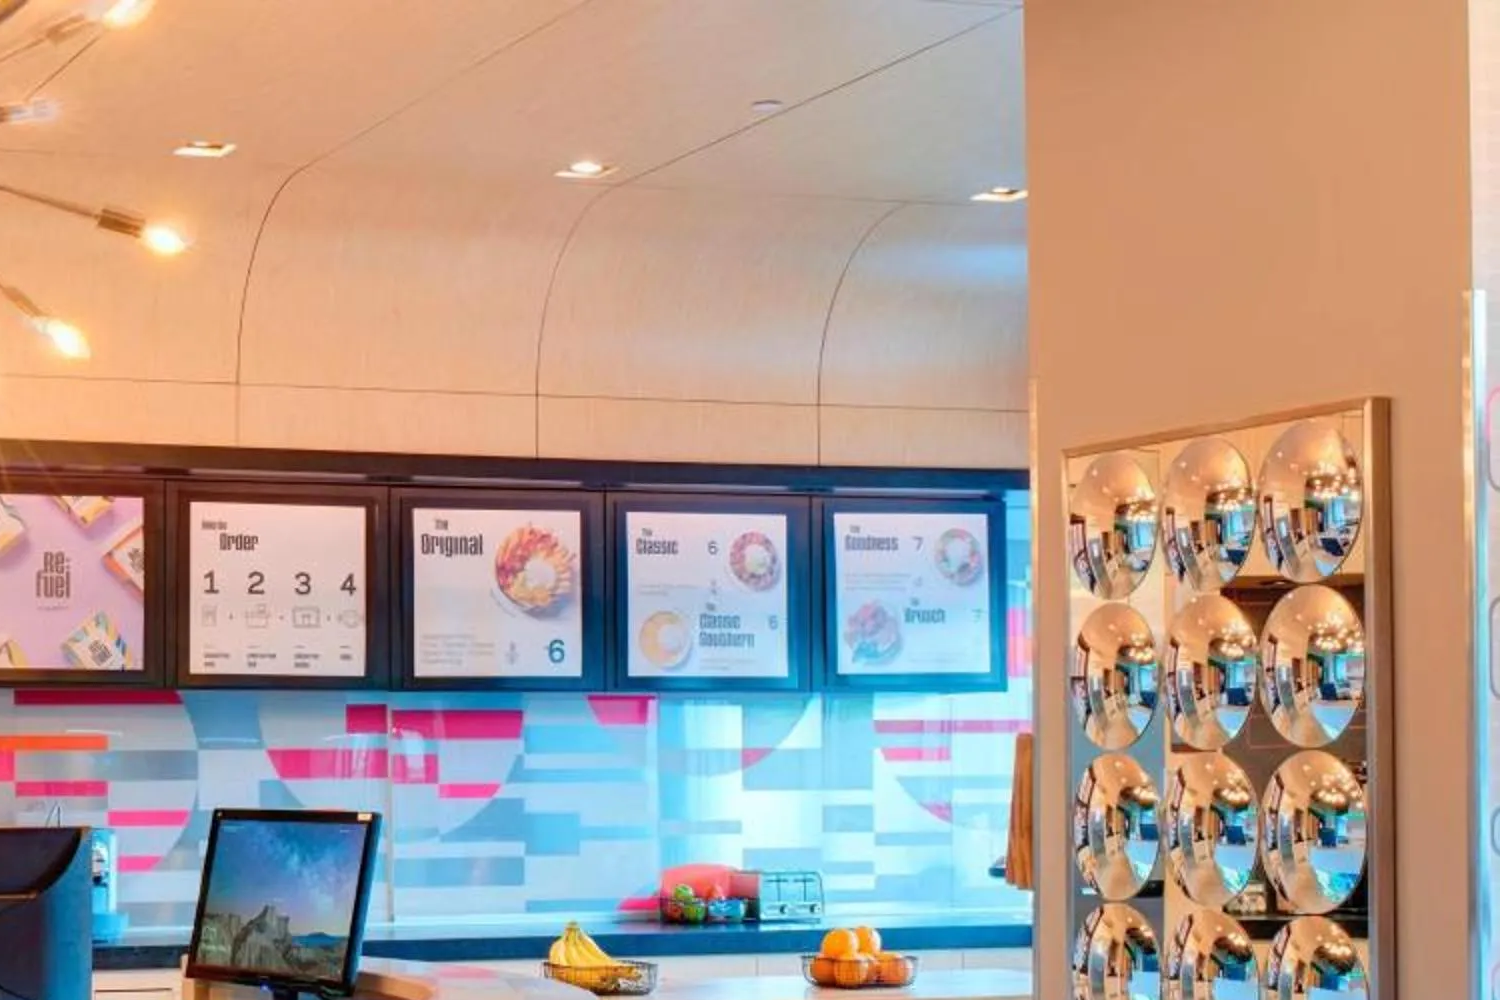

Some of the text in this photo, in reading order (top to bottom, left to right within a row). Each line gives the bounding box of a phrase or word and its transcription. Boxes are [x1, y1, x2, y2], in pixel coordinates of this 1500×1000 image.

[220, 533, 258, 551] Order
[421, 533, 483, 557] Original
[636, 538, 719, 555] Classic 6
[845, 535, 924, 551] Goodness 7
[36, 571, 71, 599] fuel
[204, 571, 357, 597] 1 2 3 4
[700, 613, 741, 629] Classic
[549, 639, 565, 663] 6
